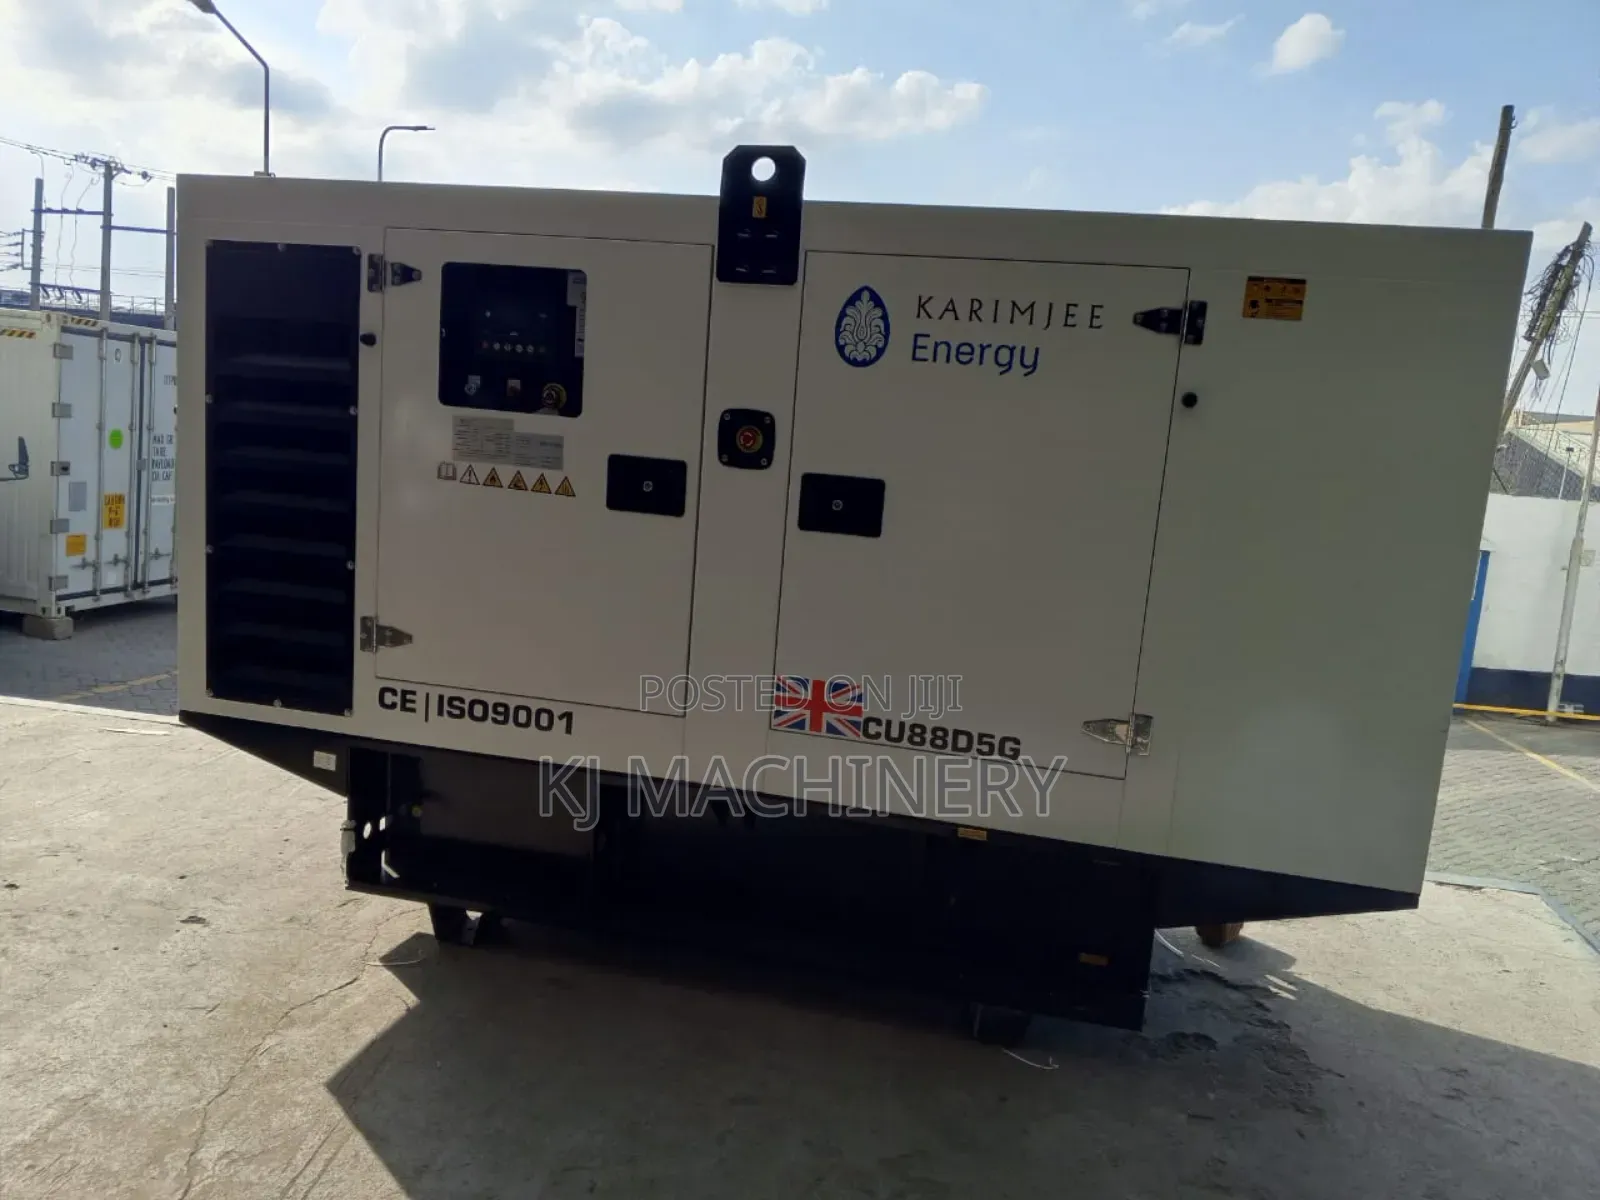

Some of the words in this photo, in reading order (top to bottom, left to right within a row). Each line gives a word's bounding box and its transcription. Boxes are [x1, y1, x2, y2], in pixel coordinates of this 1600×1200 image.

[916, 294, 1104, 331] KARIMJEE
[911, 333, 1040, 377] Energy
[862, 716, 1021, 761] CU88D5G
